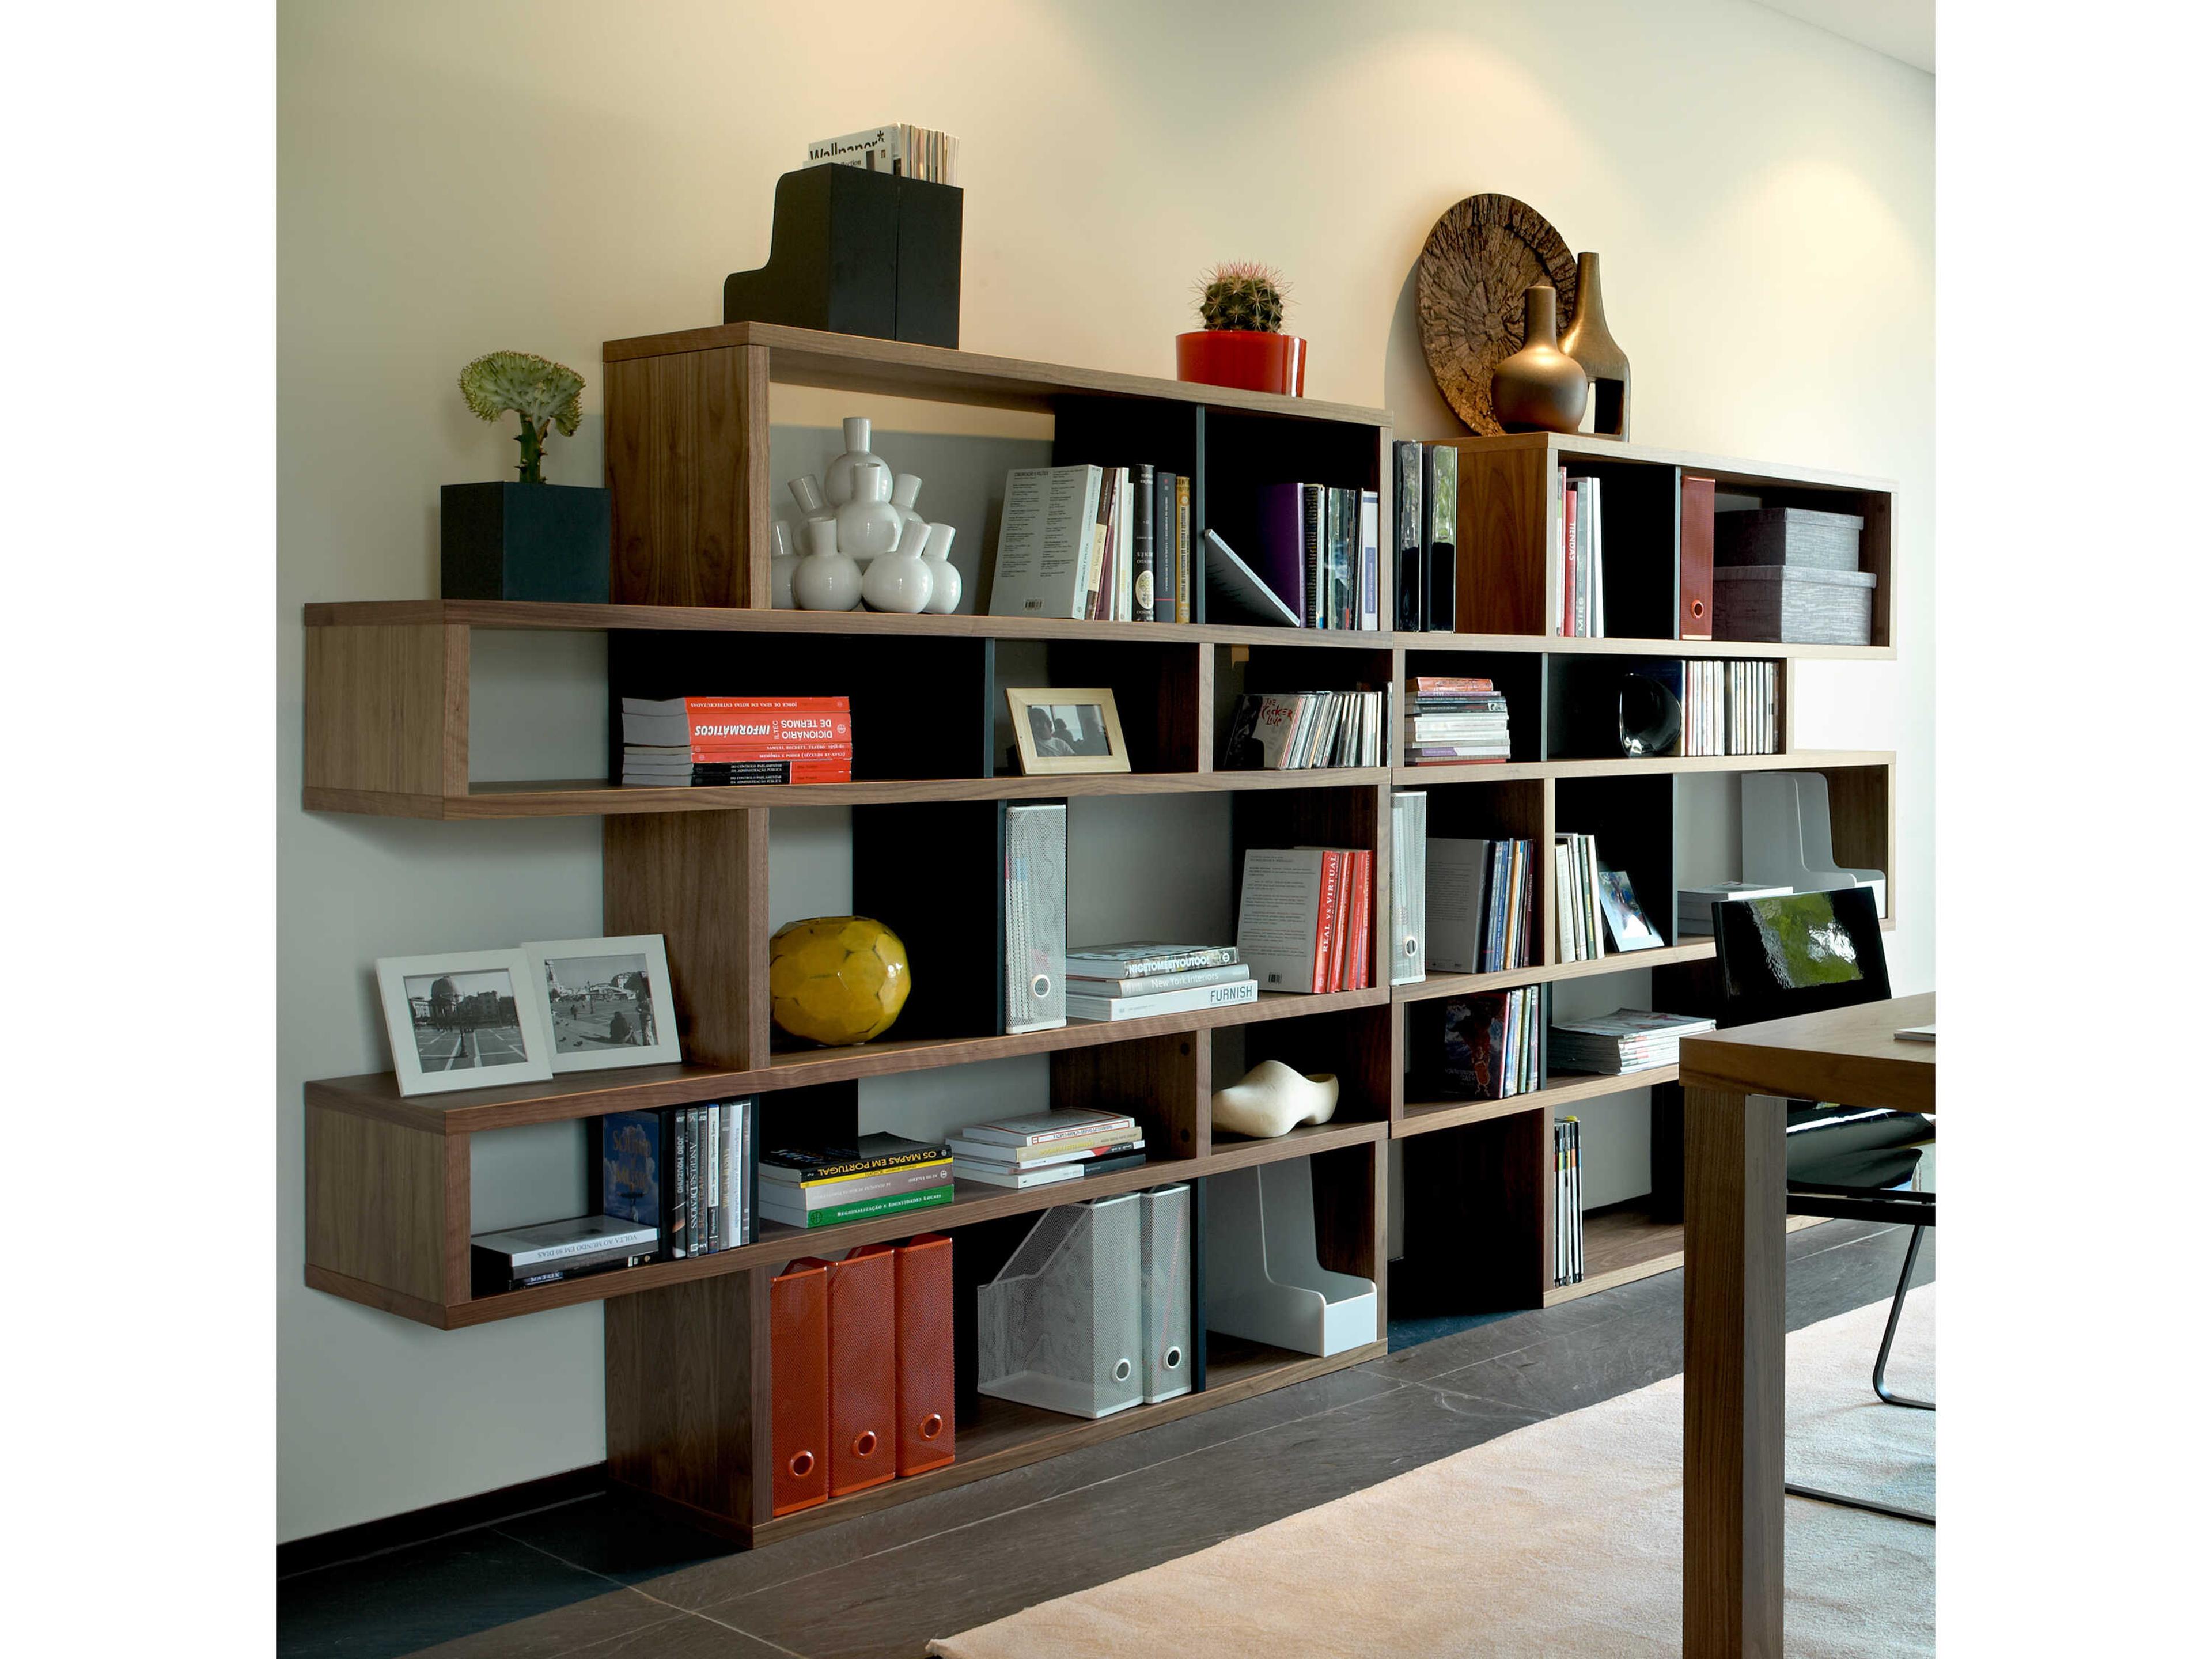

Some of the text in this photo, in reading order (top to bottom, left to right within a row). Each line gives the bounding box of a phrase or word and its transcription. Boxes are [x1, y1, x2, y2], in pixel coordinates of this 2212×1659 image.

[781, 719, 817, 728] TERMOS
[695, 725, 770, 737] INFORMÁTICOS
[782, 730, 833, 740] DICIONÁRIO
[1323, 925, 1331, 953] REAL
[1327, 855, 1337, 903] VIRTUAL
[1152, 978, 1168, 988] New
[1210, 986, 1252, 1002] FURNISH
[872, 1158, 887, 1168] EM
[888, 1153, 921, 1164] MAPAS
[818, 1162, 869, 1176] PORTUGAL
[837, 1205, 882, 1217] REGIONALIZAÇÃO
[615, 1234, 637, 1243] VOLTA
[576, 1241, 602, 1251] MUNDO
[537, 1249, 554, 1258] DIAS
